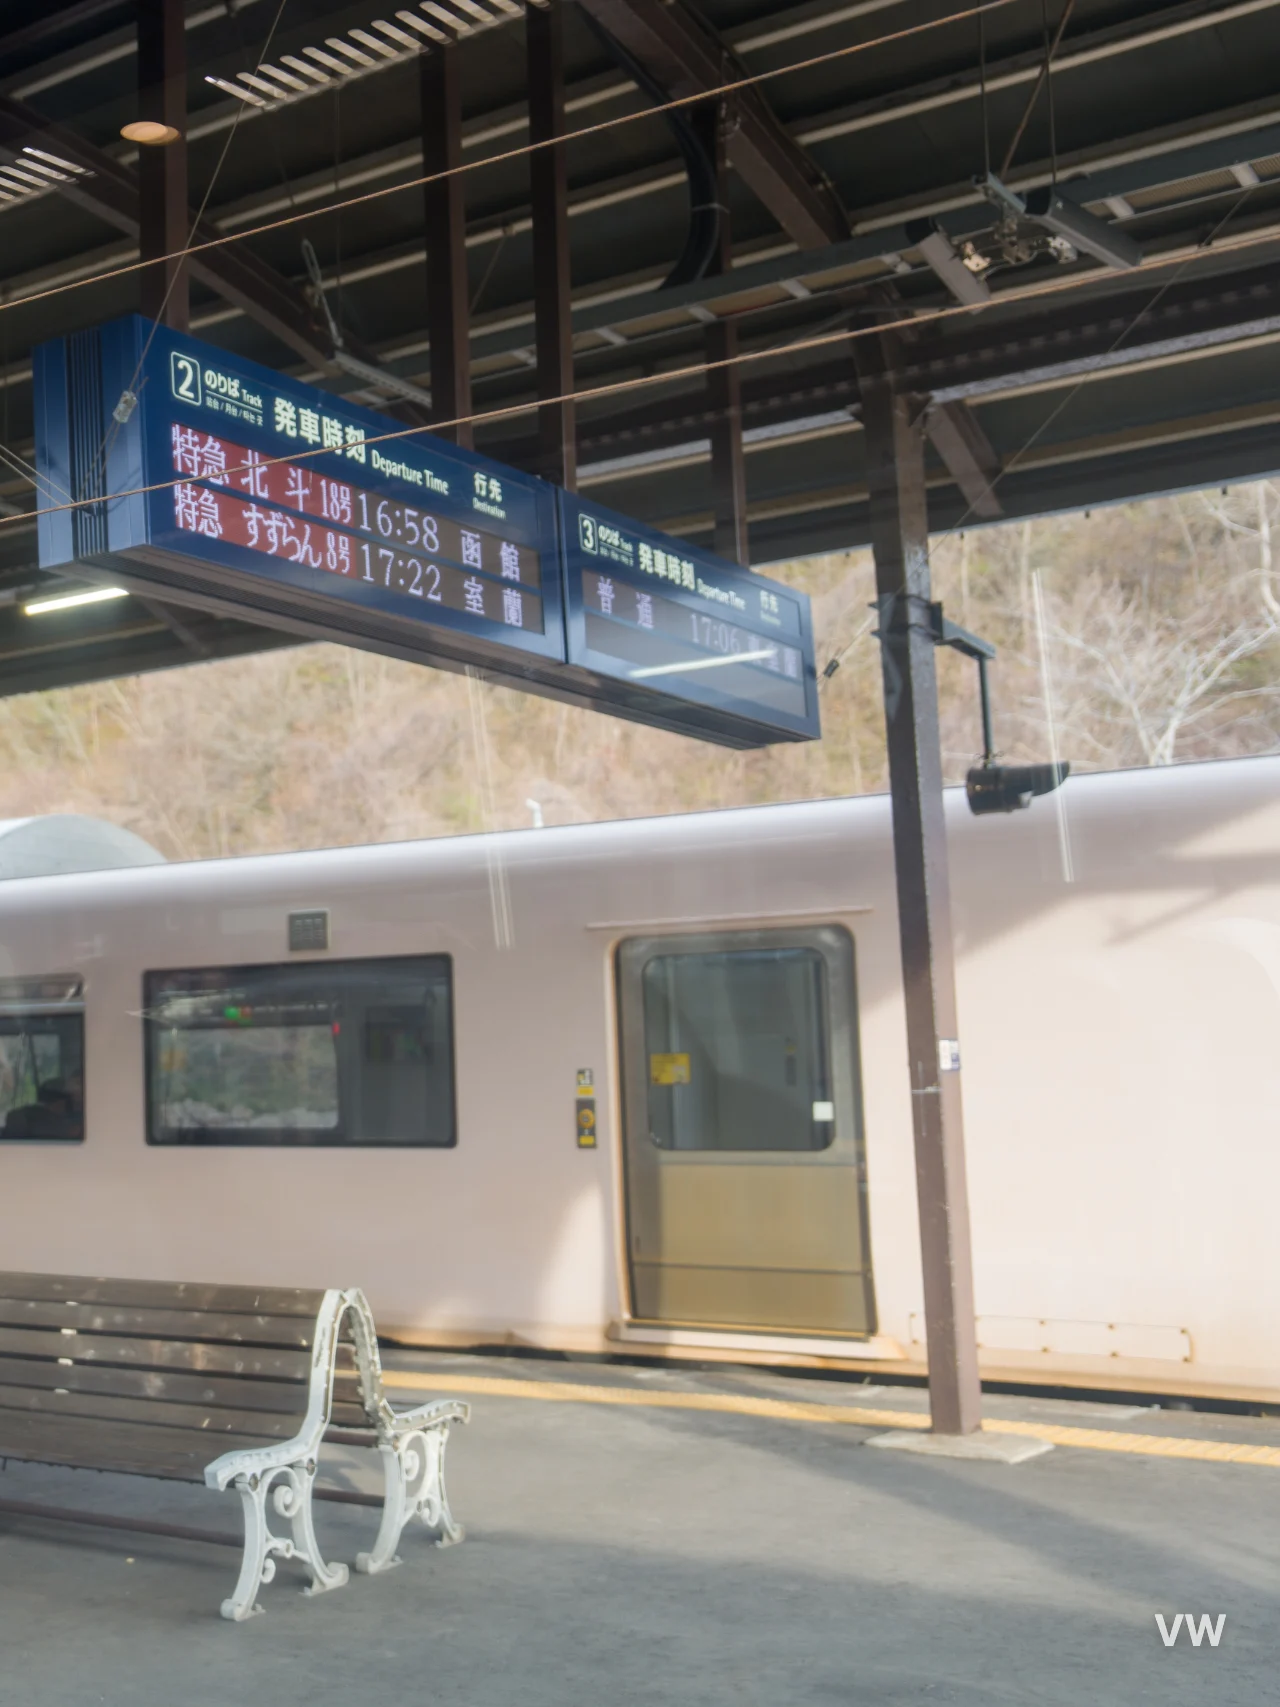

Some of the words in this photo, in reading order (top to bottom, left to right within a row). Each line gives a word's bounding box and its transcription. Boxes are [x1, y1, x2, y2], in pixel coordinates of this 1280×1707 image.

[177, 359, 195, 399] 2
[204, 369, 240, 398] のりば
[241, 388, 263, 408] Track
[172, 423, 230, 486] 特急
[273, 396, 367, 464] 発車時刻
[371, 449, 423, 486] Departure
[423, 469, 449, 496] Time
[473, 471, 503, 503] 行先
[173, 481, 223, 539] 特急
[241, 502, 323, 569] すずらん
[326, 531, 351, 575] 8号
[359, 492, 440, 553] 16:58
[582, 519, 594, 549] 3
[361, 543, 442, 602] 17:22
[638, 541, 696, 592] 発車時刻
[596, 575, 655, 630] 普通
[690, 612, 741, 656] 17:06
